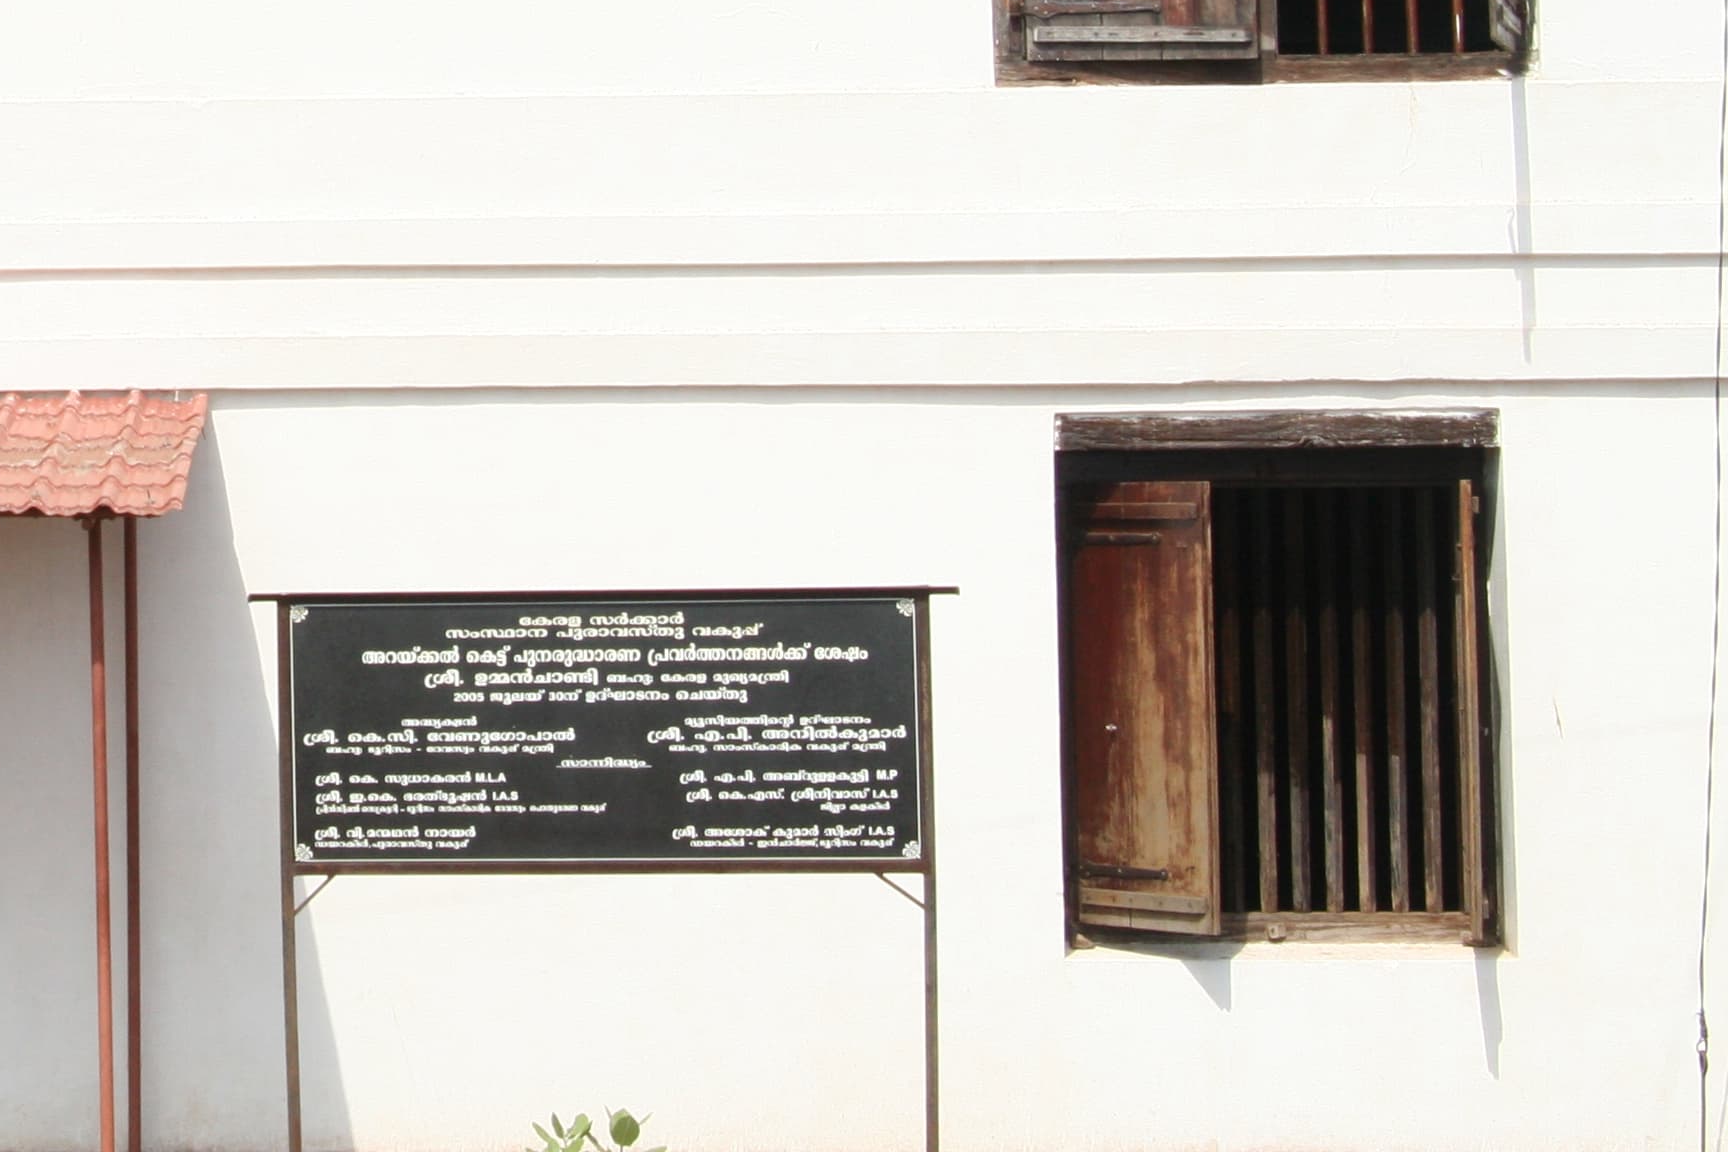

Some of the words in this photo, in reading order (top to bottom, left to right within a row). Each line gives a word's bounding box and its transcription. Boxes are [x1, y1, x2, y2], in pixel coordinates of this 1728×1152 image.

[519, 615, 582, 628] കേരള
[590, 612, 684, 627] സർക്കാർ
[444, 625, 549, 639] സംസ്ഥാന
[556, 623, 685, 641] പുരാവസ്തു
[691, 623, 764, 639] വകുപ്പ്
[362, 645, 460, 664] അറയ്ക്കൽ
[466, 645, 511, 667] കെട്ട്
[513, 648, 641, 668] പുനരുദ്ധാരണ
[647, 643, 810, 666] പ്രവർത്തനങ്ങൾക്ക്
[814, 646, 869, 662] ശേഷം
[424, 668, 464, 688] ശ്രീ.
[660, 673, 707, 684] കേരള
[453, 692, 485, 702] 2005
[675, 687, 748, 703] ചെയ്തു
[303, 729, 339, 745] ശ്രീ.
[427, 727, 576, 744] വേണുഗോപാൽ
[647, 726, 684, 743] ശ്രീ.
[315, 772, 342, 786] ശ്രീ.
[475, 772, 506, 783] M.L.A
[680, 770, 707, 784] ശ്രീ.
[876, 769, 898, 780] M.P
[315, 790, 344, 805] ശ്രീ.
[492, 791, 518, 801] I.A.S
[686, 788, 712, 803] ശ്രീ.
[873, 789, 898, 799] I.A.S
[315, 826, 340, 840] ശ്രീ.
[424, 825, 476, 840] നായർ
[672, 825, 698, 840] ശ്രീ.
[868, 826, 895, 837] I.A.S
